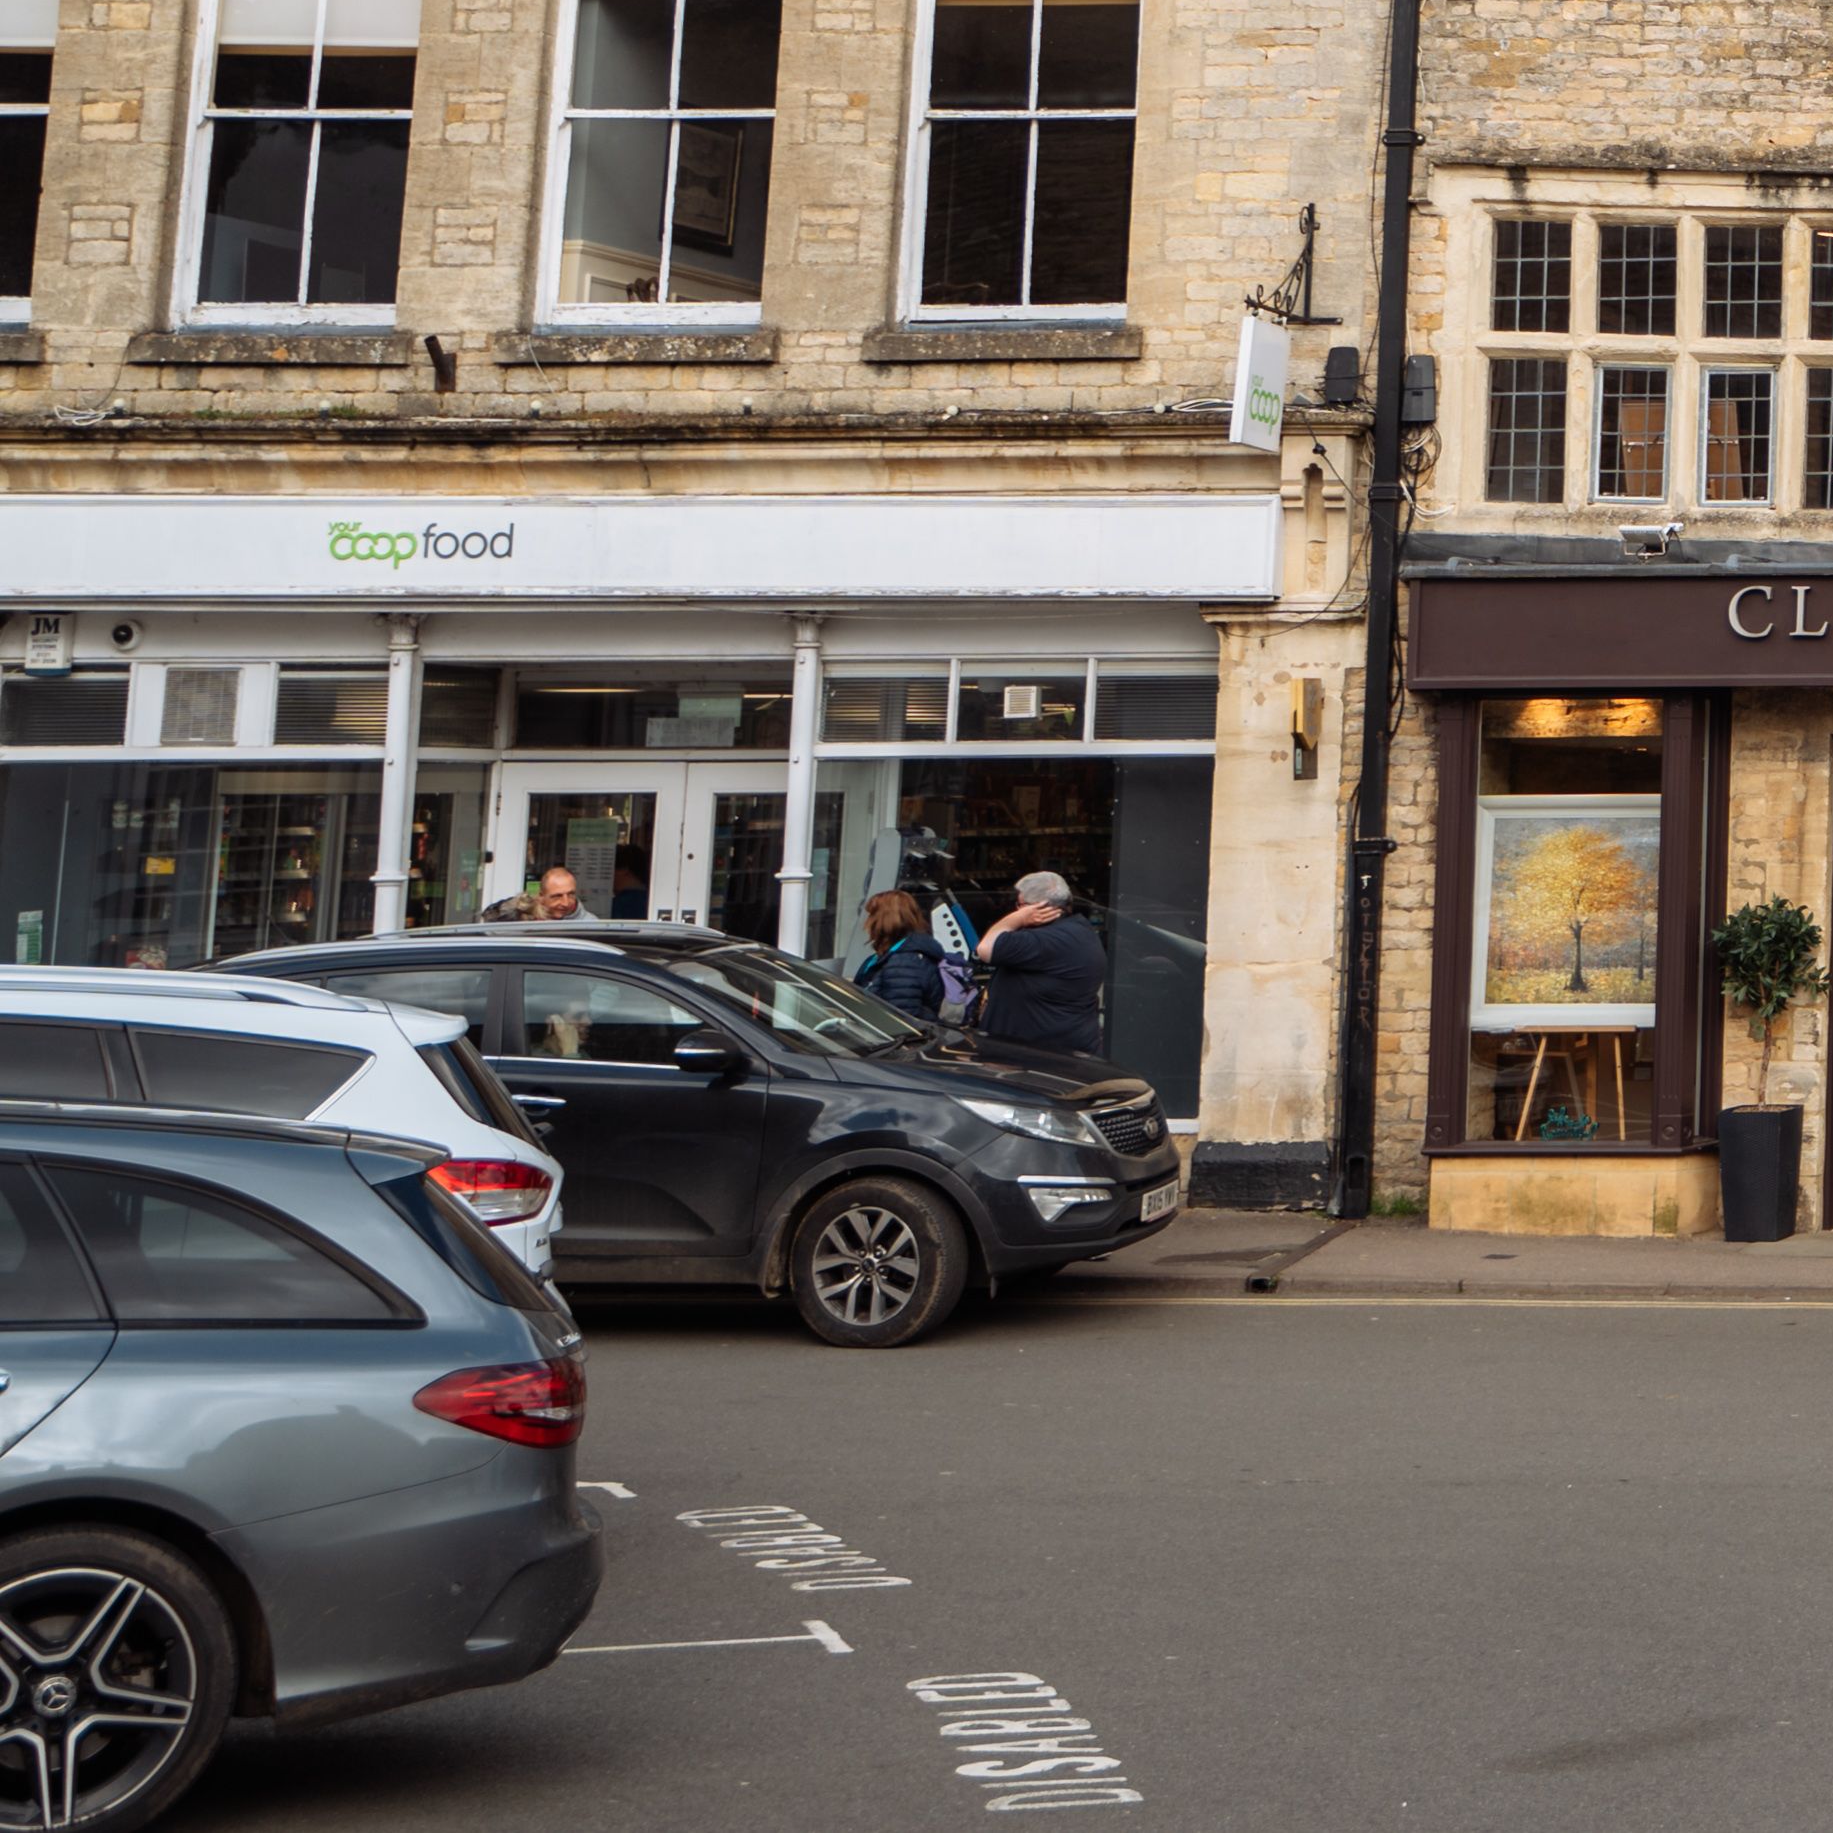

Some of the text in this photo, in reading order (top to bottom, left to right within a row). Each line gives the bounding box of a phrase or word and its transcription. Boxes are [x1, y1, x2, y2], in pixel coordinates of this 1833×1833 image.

[328, 521, 362, 535] your
[329, 522, 515, 570] coop food
[31, 618, 60, 636] JM
[675, 1505, 912, 1591] DISABLED
[906, 1672, 1143, 1811] DISABLED
